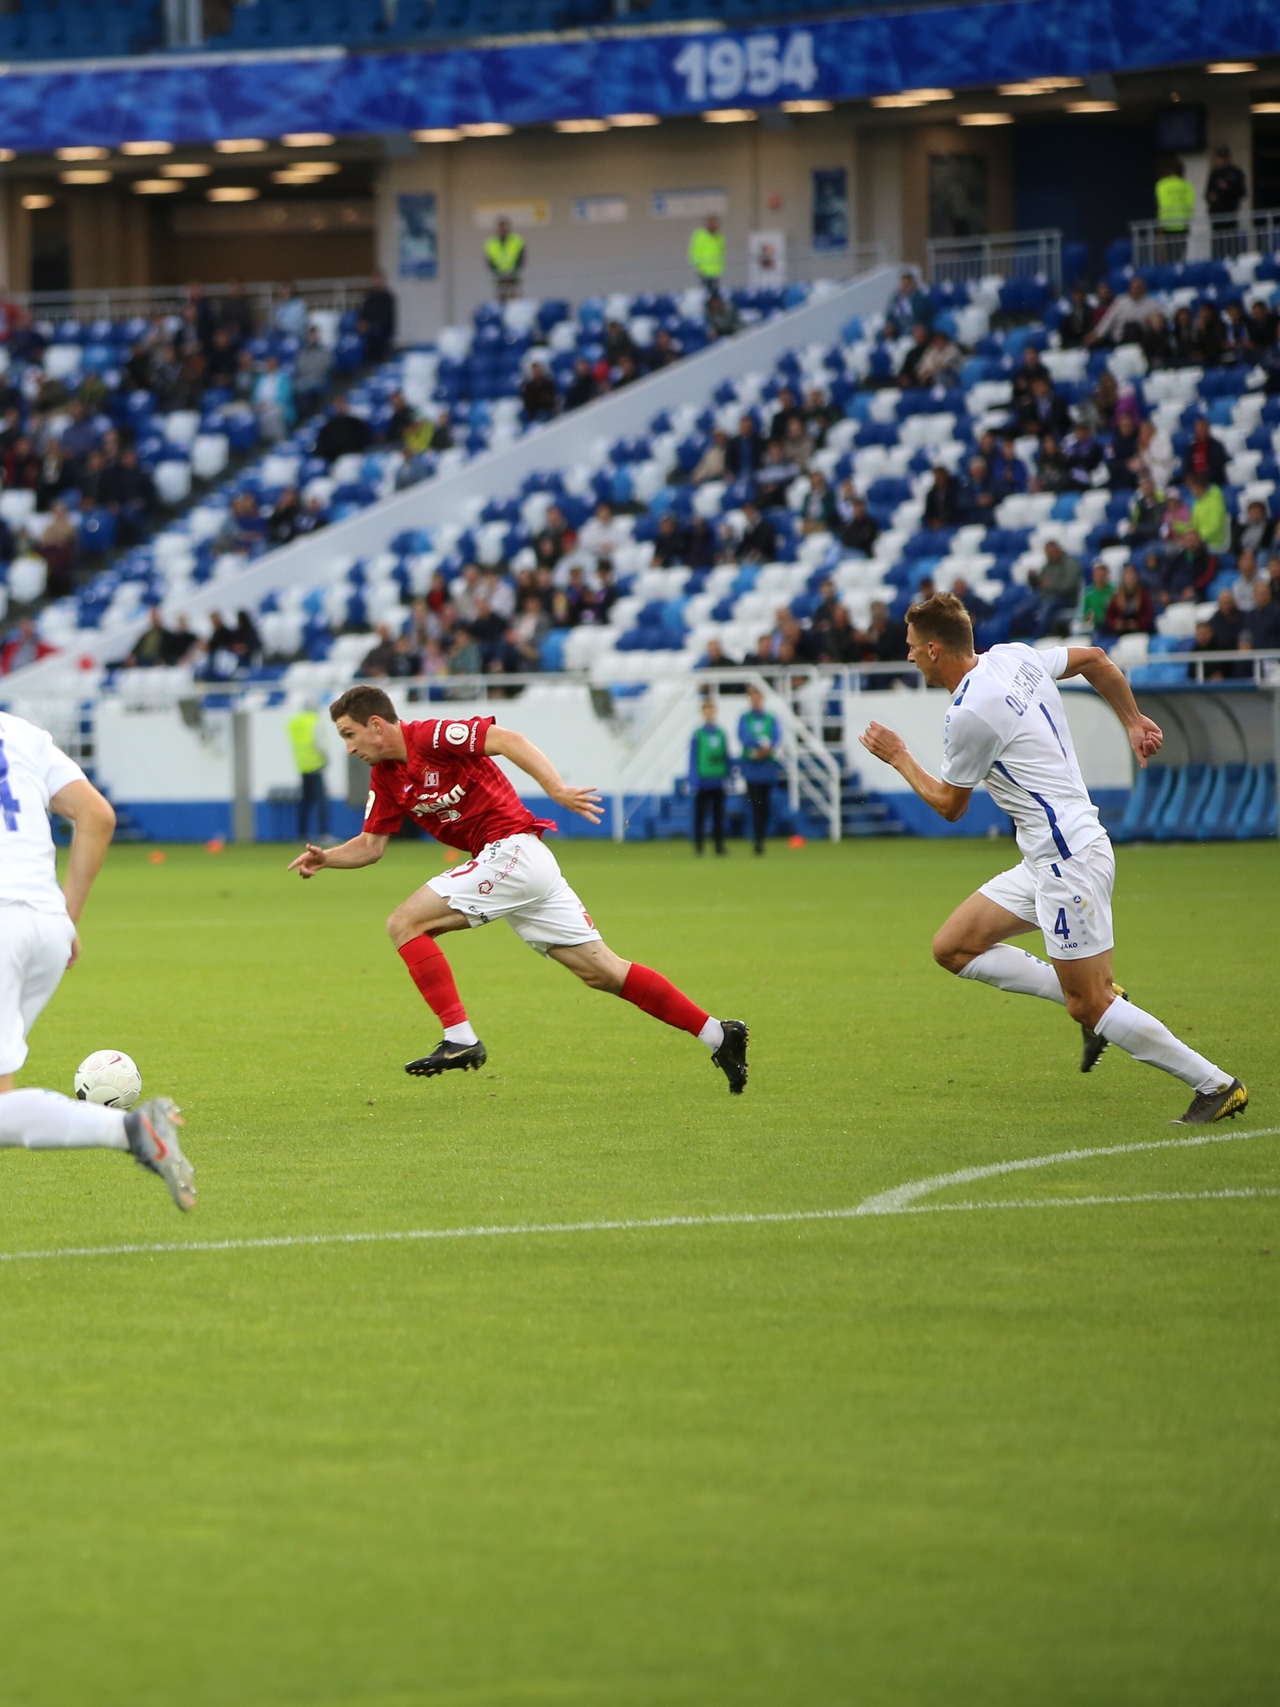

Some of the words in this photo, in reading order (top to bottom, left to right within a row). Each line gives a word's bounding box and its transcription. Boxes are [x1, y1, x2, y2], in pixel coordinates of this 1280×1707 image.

[674, 32, 818, 99] 1954
[1054, 907, 1070, 940] 4
[1061, 942, 1078, 950] JAKO
